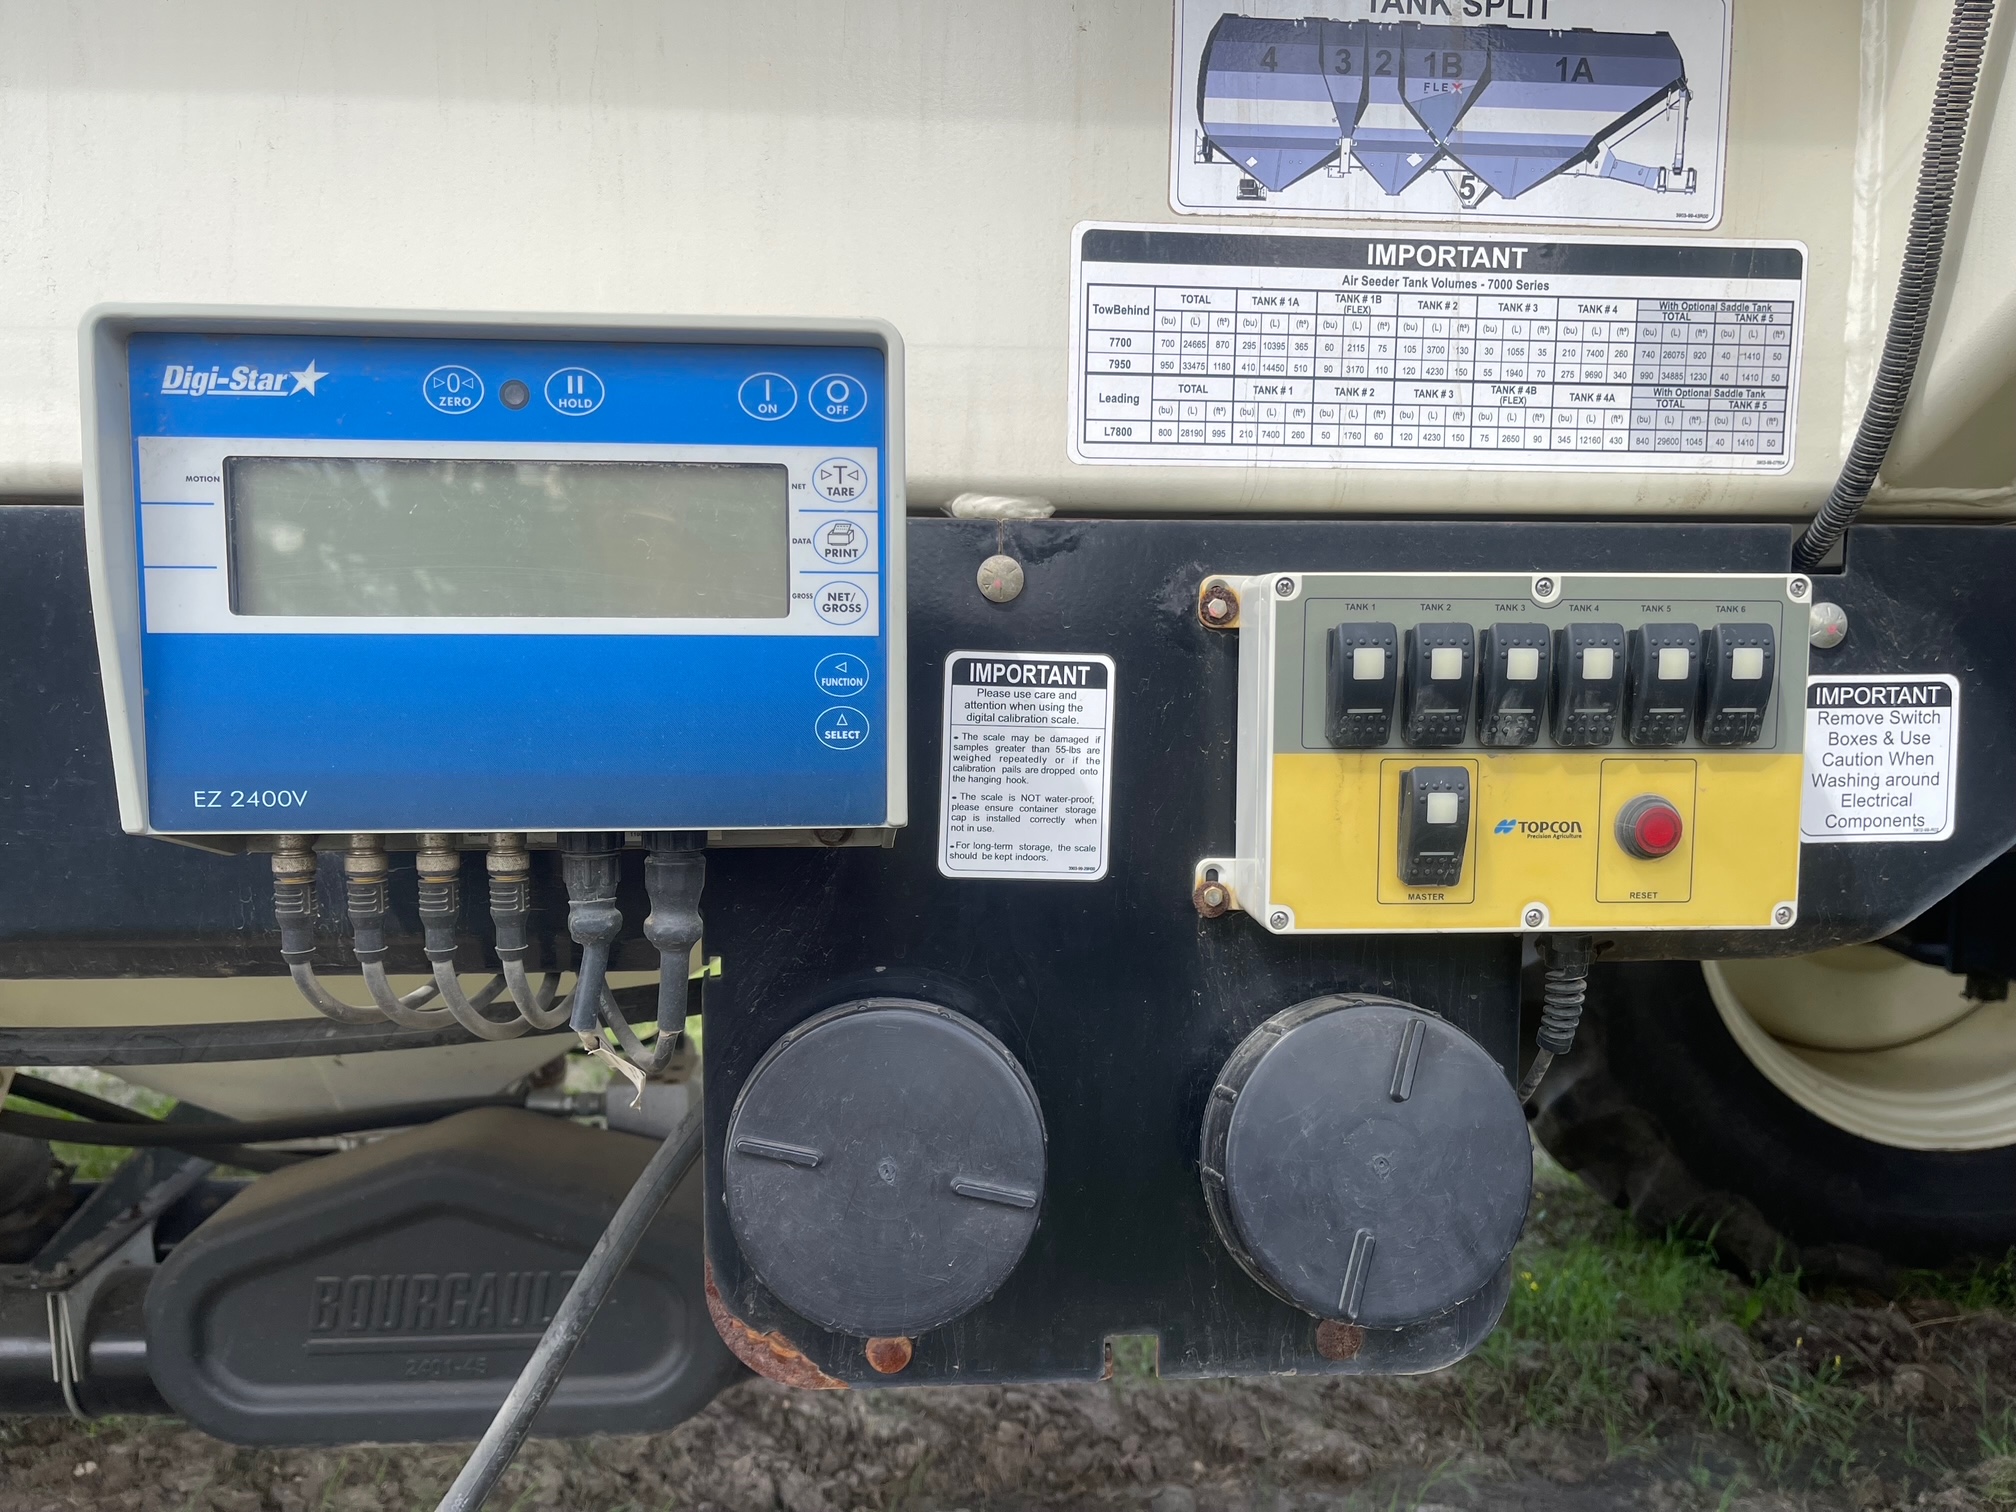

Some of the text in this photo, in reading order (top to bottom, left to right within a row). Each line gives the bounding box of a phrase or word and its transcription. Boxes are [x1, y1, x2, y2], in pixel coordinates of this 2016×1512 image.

[1261, 48, 1278, 71] 4
[1335, 50, 1352, 74] 3
[1375, 51, 1391, 76] 2
[1424, 52, 1462, 78] 1B
[1555, 56, 1594, 82] 1A
[1423, 82, 1463, 94] FLEX
[1460, 174, 1477, 197] 5
[1366, 244, 1528, 269] IMPORTANT
[1342, 275, 1358, 287] Air
[1361, 276, 1399, 288] Seeder
[1403, 277, 1427, 288] Tank
[1432, 278, 1477, 290] Volumes
[1488, 279, 1513, 290] 7000
[1516, 280, 1549, 291] Series
[1181, 294, 1211, 305] TOTAL
[1252, 296, 1299, 307] TANK # 1A
[1335, 294, 1382, 304] TANK # 1B
[1093, 304, 1150, 316] TowBehind
[1343, 305, 1371, 315] (FLEX)
[1659, 301, 1772, 313] With Optional Saddle Tank
[1109, 337, 1230, 349] 7700 700 24665 870
[1109, 359, 1131, 369] 7950
[161, 366, 289, 396] Digi-Star
[1178, 384, 1208, 394] TOTAL
[439, 396, 471, 407] ZERO
[559, 399, 592, 408] HOLD
[1099, 393, 1140, 406] Leading
[758, 404, 778, 414] ON
[827, 405, 848, 415] OFF
[1104, 427, 1226, 439] L7800 800 28190 995
[827, 487, 854, 496] TARE
[825, 549, 858, 558] PRINT
[792, 592, 813, 600] GROSS
[828, 592, 856, 602] NET/
[822, 603, 861, 612] GROSS
[969, 662, 1090, 685] IMPORTANT
[821, 677, 863, 687] FUNCTION
[977, 689, 1076, 700] Please use care and
[1816, 686, 1941, 705] IMPORTANT
[964, 702, 1083, 713] attention when using the
[966, 713, 1079, 724] digital calibration scale.
[1818, 710, 1940, 725] Remove Switch
[824, 730, 860, 740] SELECT
[962, 733, 978, 741] The
[1050, 735, 1089, 745] damaged
[1828, 731, 1930, 746] Boxes & Use
[953, 744, 988, 753] samples
[995, 746, 1025, 754] greater
[953, 755, 991, 763] weighed
[1000, 756, 1047, 765] repeatedly
[1822, 752, 1934, 767] Caution When
[953, 765, 995, 773] calibration
[1002, 766, 1021, 775] pails
[1041, 767, 1075, 776] dropped
[968, 776, 1001, 785] hanging
[1006, 776, 1028, 784] hook.
[1812, 772, 1939, 790] Washing around
[194, 790, 308, 808] EZ 2400V
[1021, 794, 1040, 802] NOT
[1045, 795, 1094, 804] water-proof;
[1841, 793, 1912, 807] Electrical
[952, 804, 979, 812] please
[1019, 805, 1058, 813] container
[1065, 806, 1096, 815] storage
[951, 815, 966, 823] cap
[1030, 816, 1065, 825] correctly
[1826, 813, 1925, 830] Components
[1518, 822, 1582, 833] TOPCON
[973, 842, 1013, 852] long-term
[1019, 844, 1052, 852] storage,
[950, 852, 977, 860] should
[994, 853, 1012, 862] kept
[1015, 853, 1048, 861] indoors.
[1408, 893, 1444, 901] MASTER
